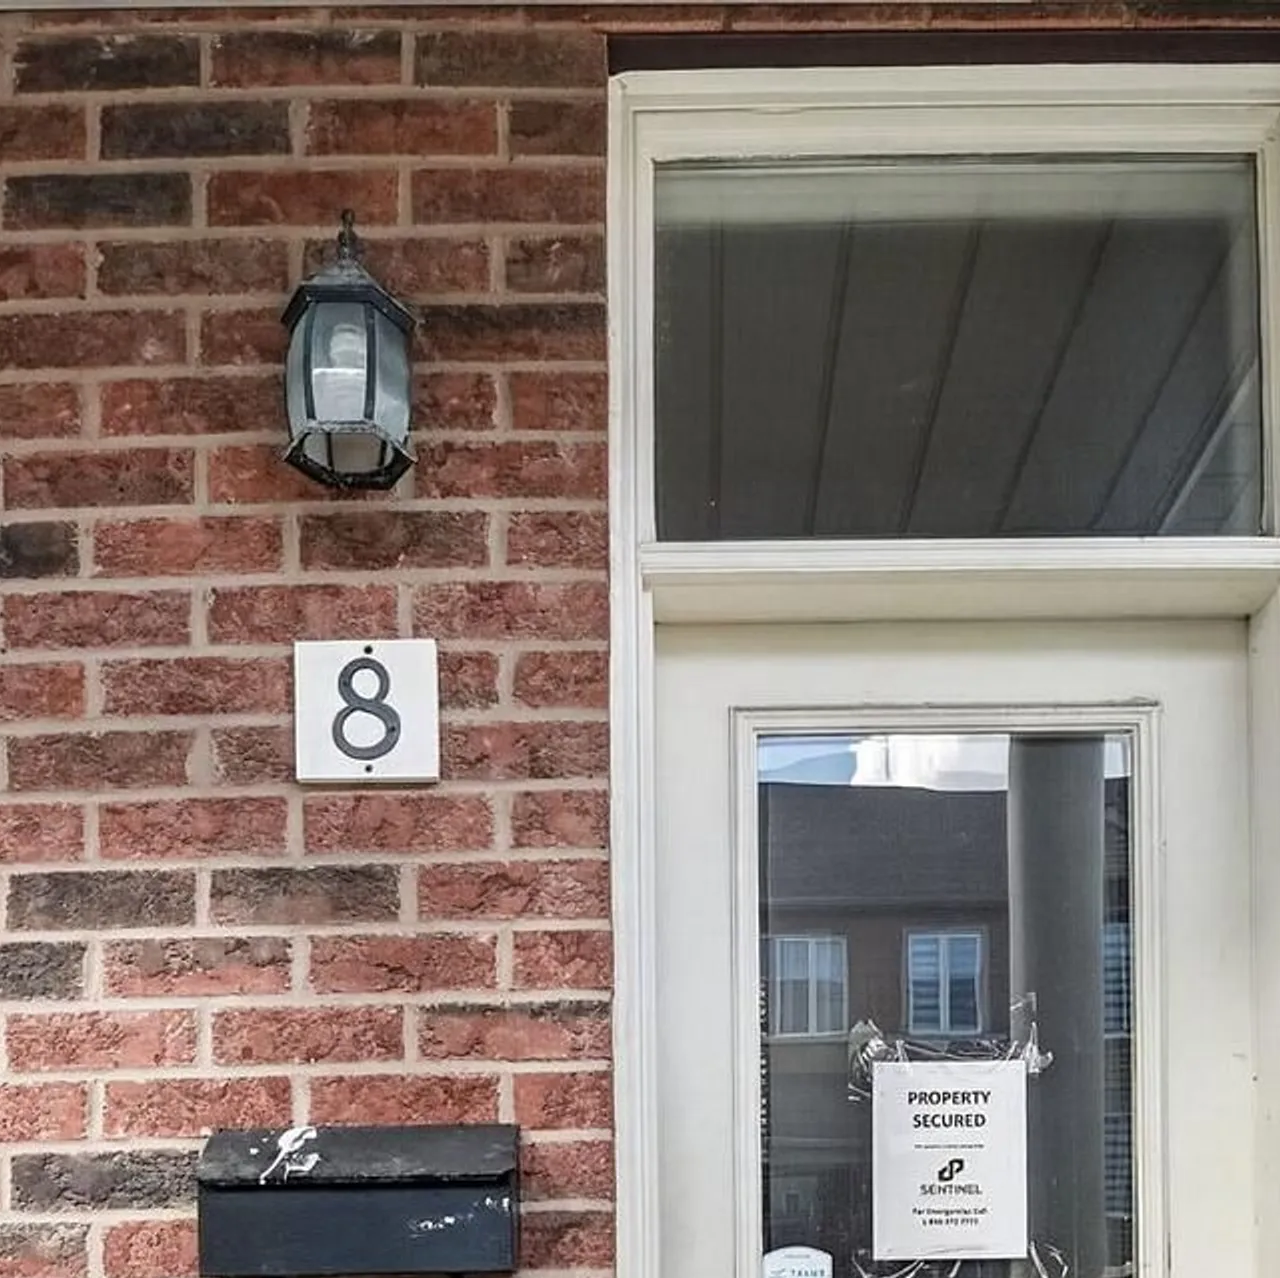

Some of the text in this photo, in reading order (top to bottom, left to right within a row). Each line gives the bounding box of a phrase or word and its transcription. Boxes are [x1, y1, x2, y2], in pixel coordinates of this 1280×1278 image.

[331, 657, 402, 761] 8
[907, 1091, 991, 1105] PROPERTY
[913, 1113, 987, 1129] SECURED
[920, 1184, 983, 1195] SENTINEL
